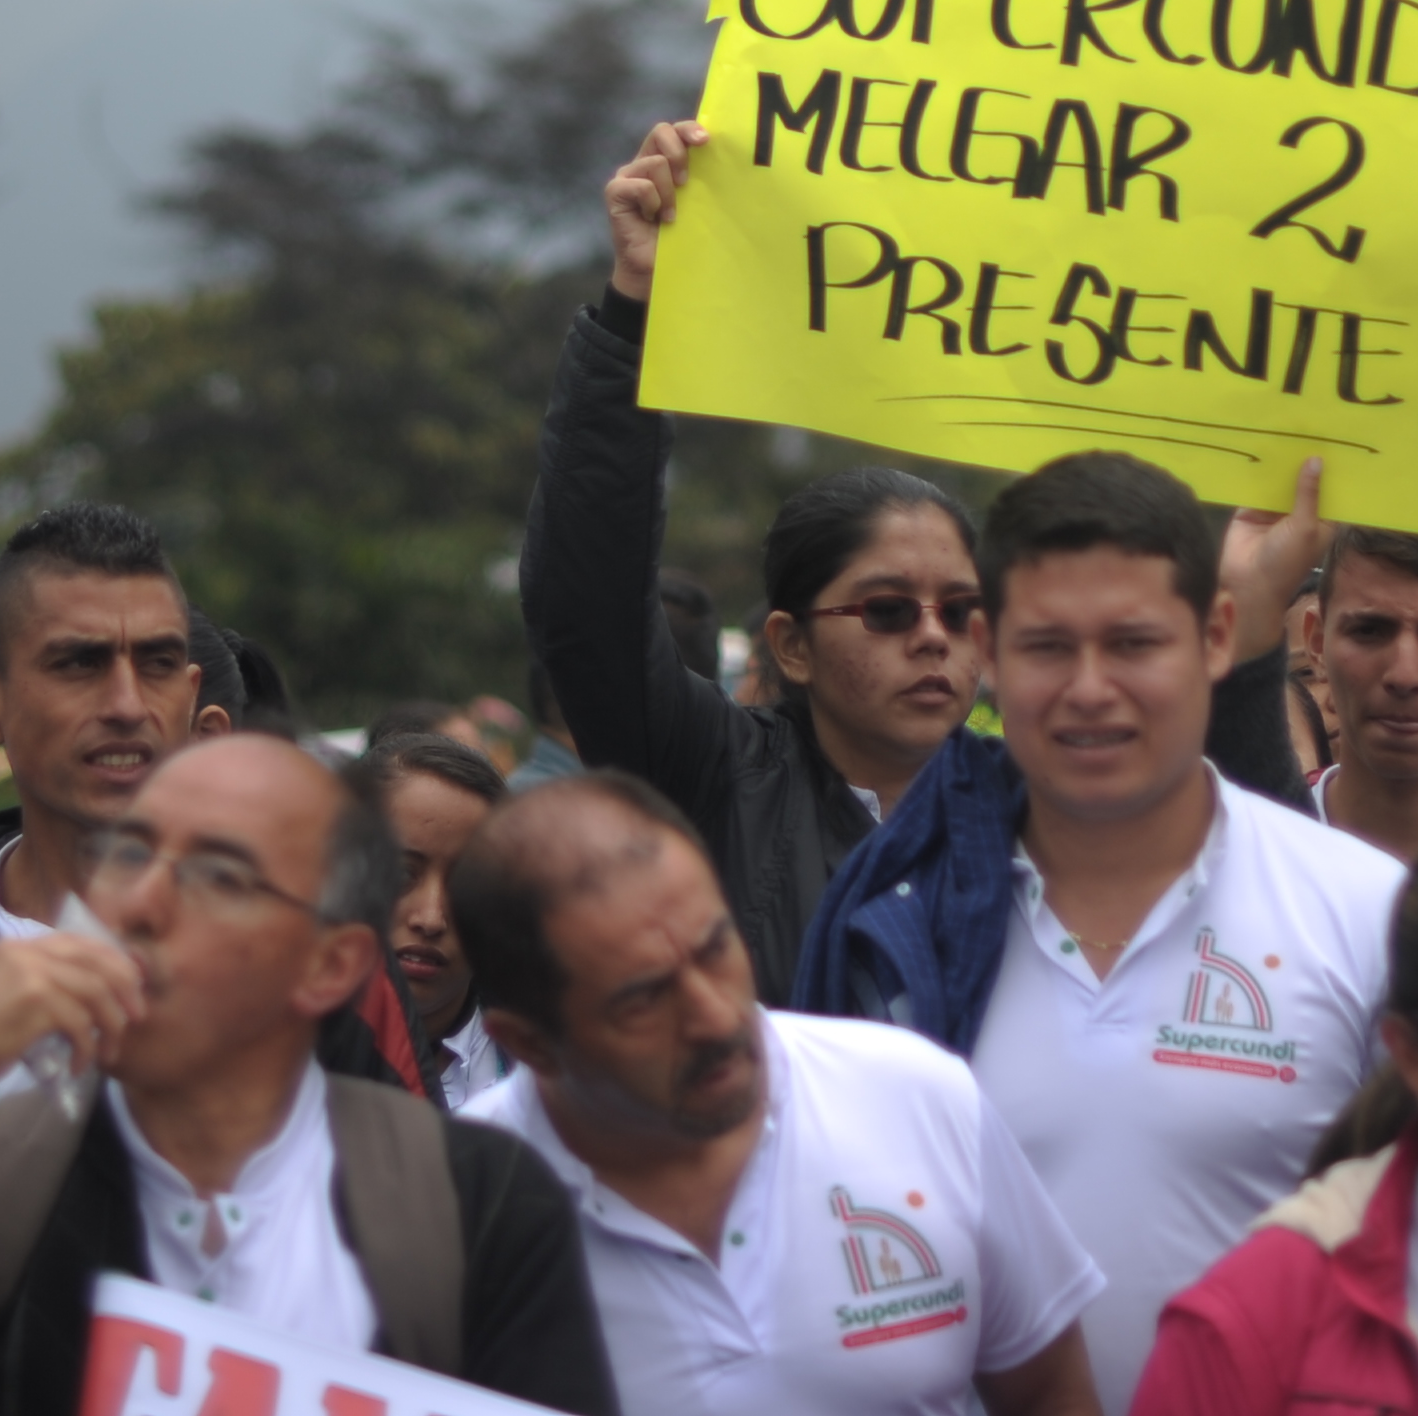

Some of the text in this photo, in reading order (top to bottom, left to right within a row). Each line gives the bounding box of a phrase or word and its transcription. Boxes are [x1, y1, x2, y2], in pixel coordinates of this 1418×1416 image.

[752, 68, 1367, 264] MELGAR 2
[1155, 1024, 1297, 1062] Supercundi
[835, 1277, 965, 1330] Supercundi
